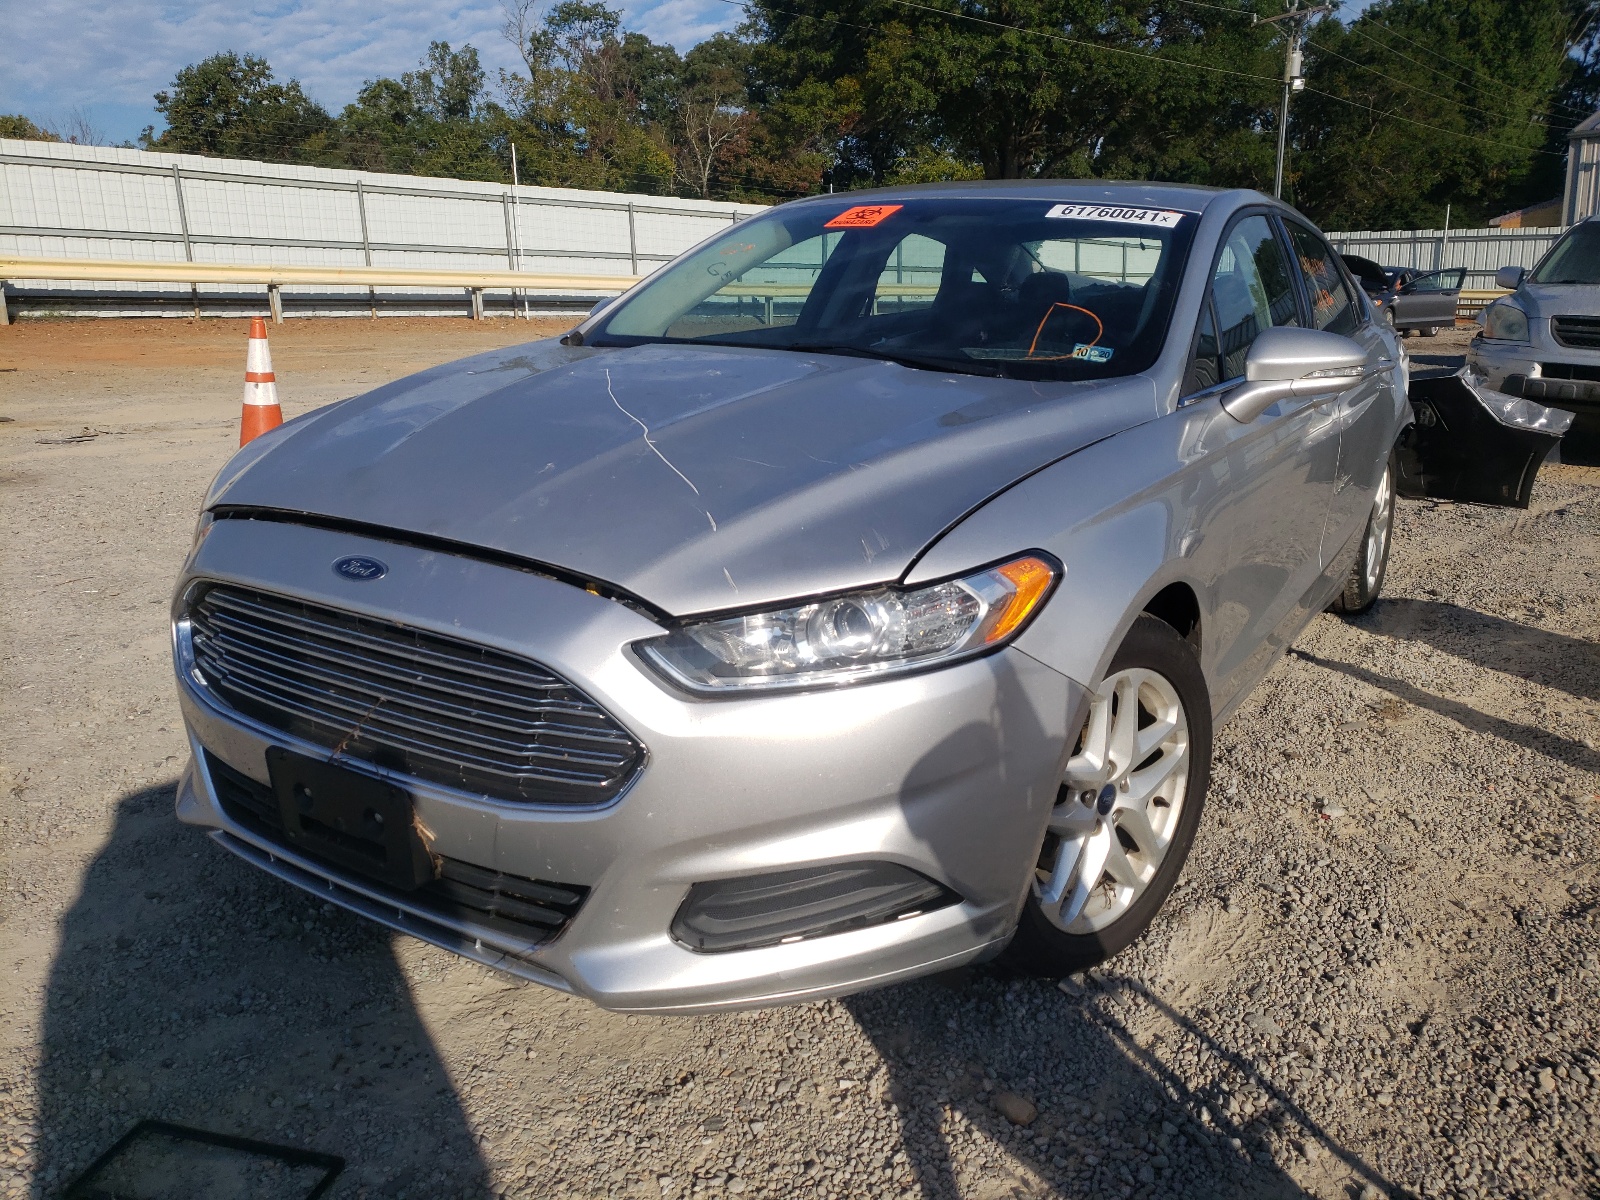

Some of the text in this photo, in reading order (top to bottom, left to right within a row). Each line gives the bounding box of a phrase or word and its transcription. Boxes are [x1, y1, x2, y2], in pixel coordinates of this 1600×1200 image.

[1075, 347, 1111, 359] 10 20
[342, 560, 376, 576] Ford
